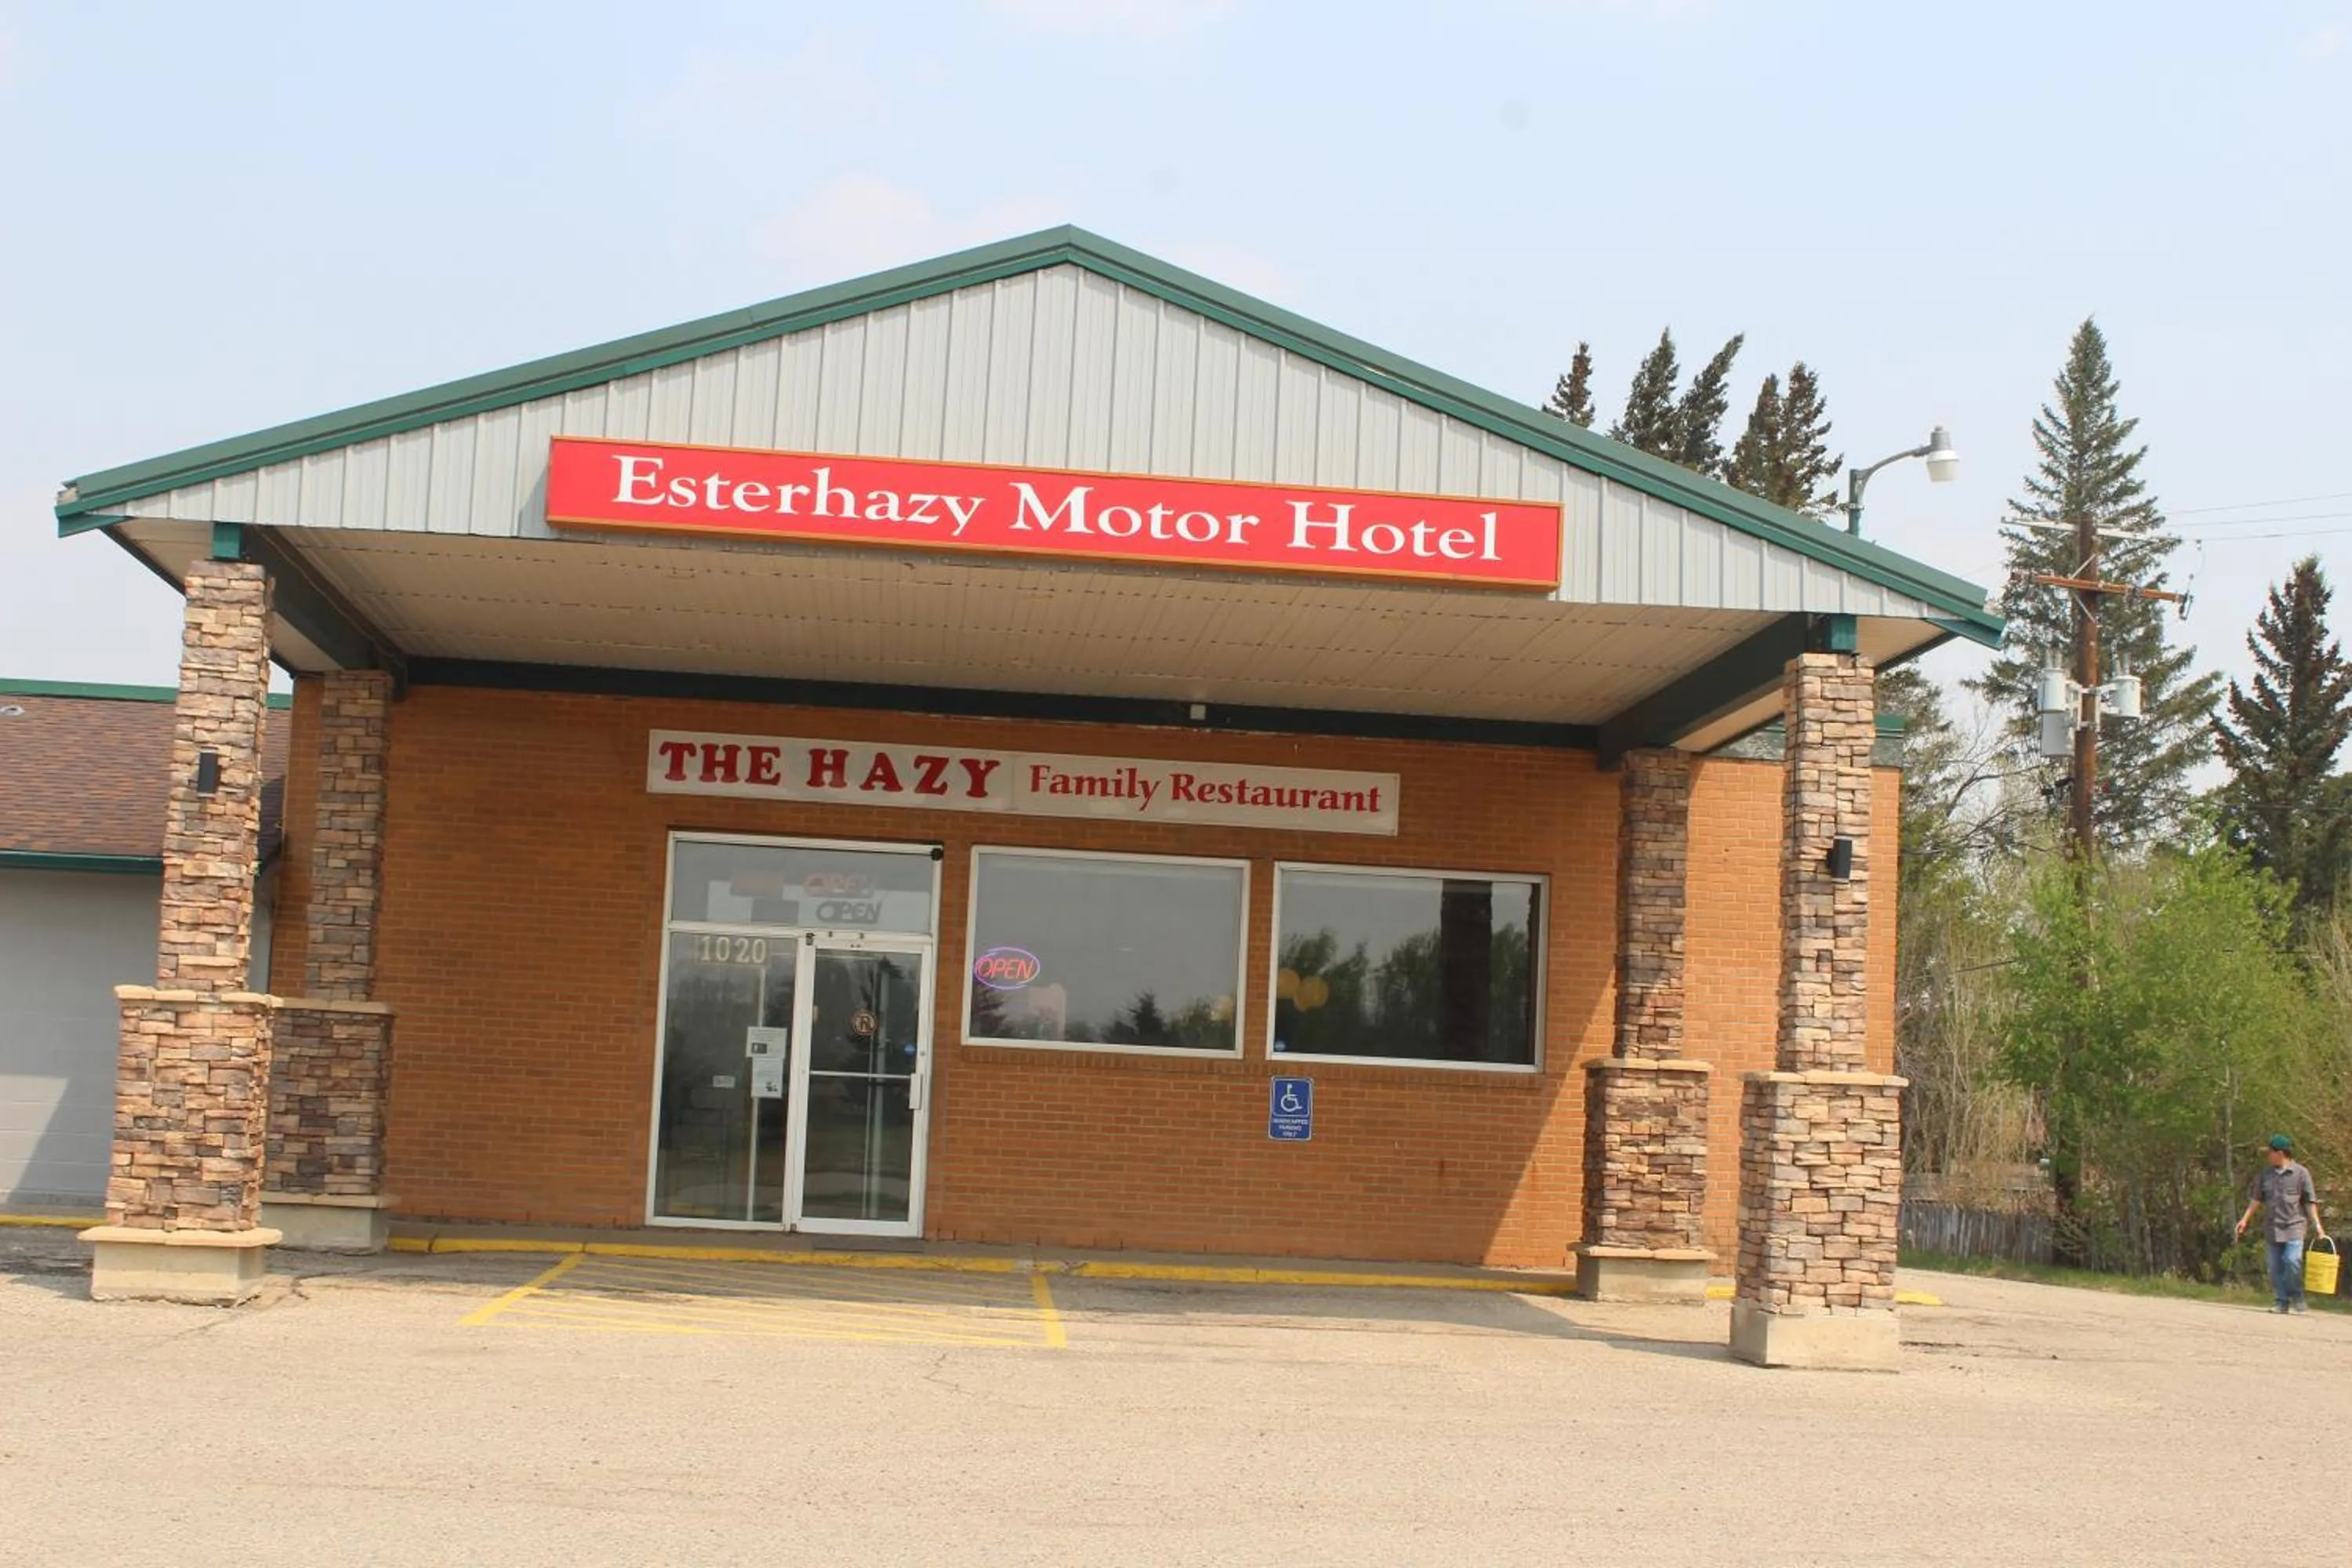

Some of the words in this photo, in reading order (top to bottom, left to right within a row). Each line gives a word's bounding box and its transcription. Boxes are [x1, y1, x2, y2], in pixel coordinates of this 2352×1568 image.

[612, 454, 986, 537] Esterhazy
[1008, 481, 1260, 545] Motor
[1285, 499, 1502, 562] Hotel
[659, 741, 782, 786] THE
[805, 748, 1000, 798] HAZY
[1029, 764, 1161, 811] Family
[1169, 772, 1381, 814] Restaurant
[816, 900, 882, 924] OPEN
[700, 935, 768, 964] 1020
[978, 956, 1034, 980] OPEN
